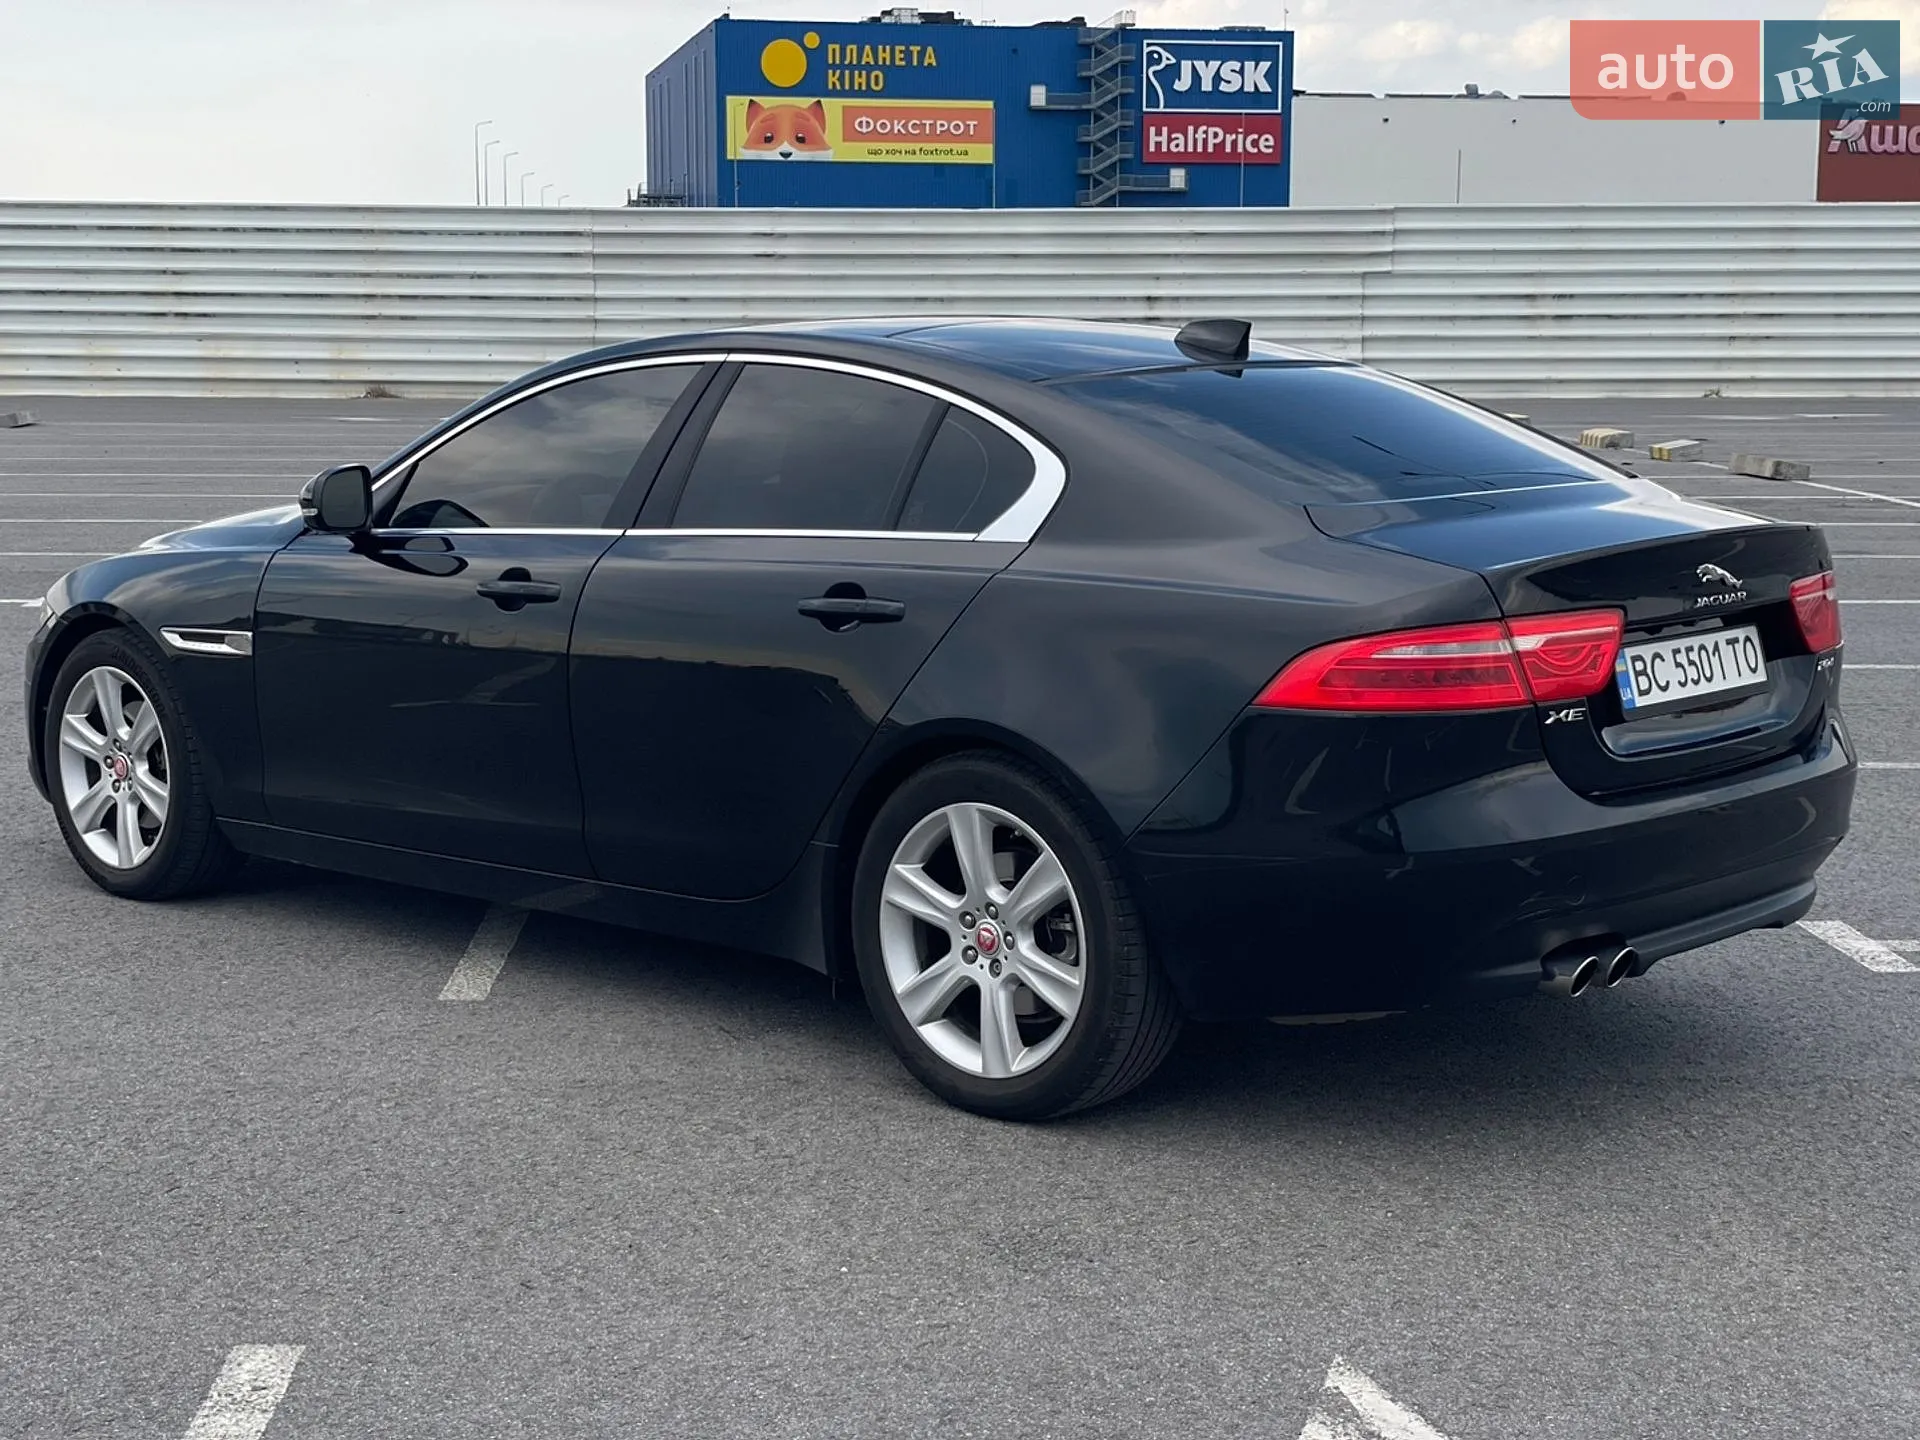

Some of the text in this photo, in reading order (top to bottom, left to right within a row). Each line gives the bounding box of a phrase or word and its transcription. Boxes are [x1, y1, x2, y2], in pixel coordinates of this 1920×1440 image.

[827, 44, 937, 66] ПЛАНЕТА
[827, 69, 884, 90] КІНО
[1173, 60, 1272, 93] JYSK
[854, 116, 978, 135] ФОКСТРОТ
[1149, 125, 1275, 153] HalfPrice
[919, 147, 969, 157] foxtrot.ua
[1694, 591, 1747, 608] JAGUAR
[1630, 635, 1759, 697] BC 5501 TO
[1544, 707, 1587, 725] XE
